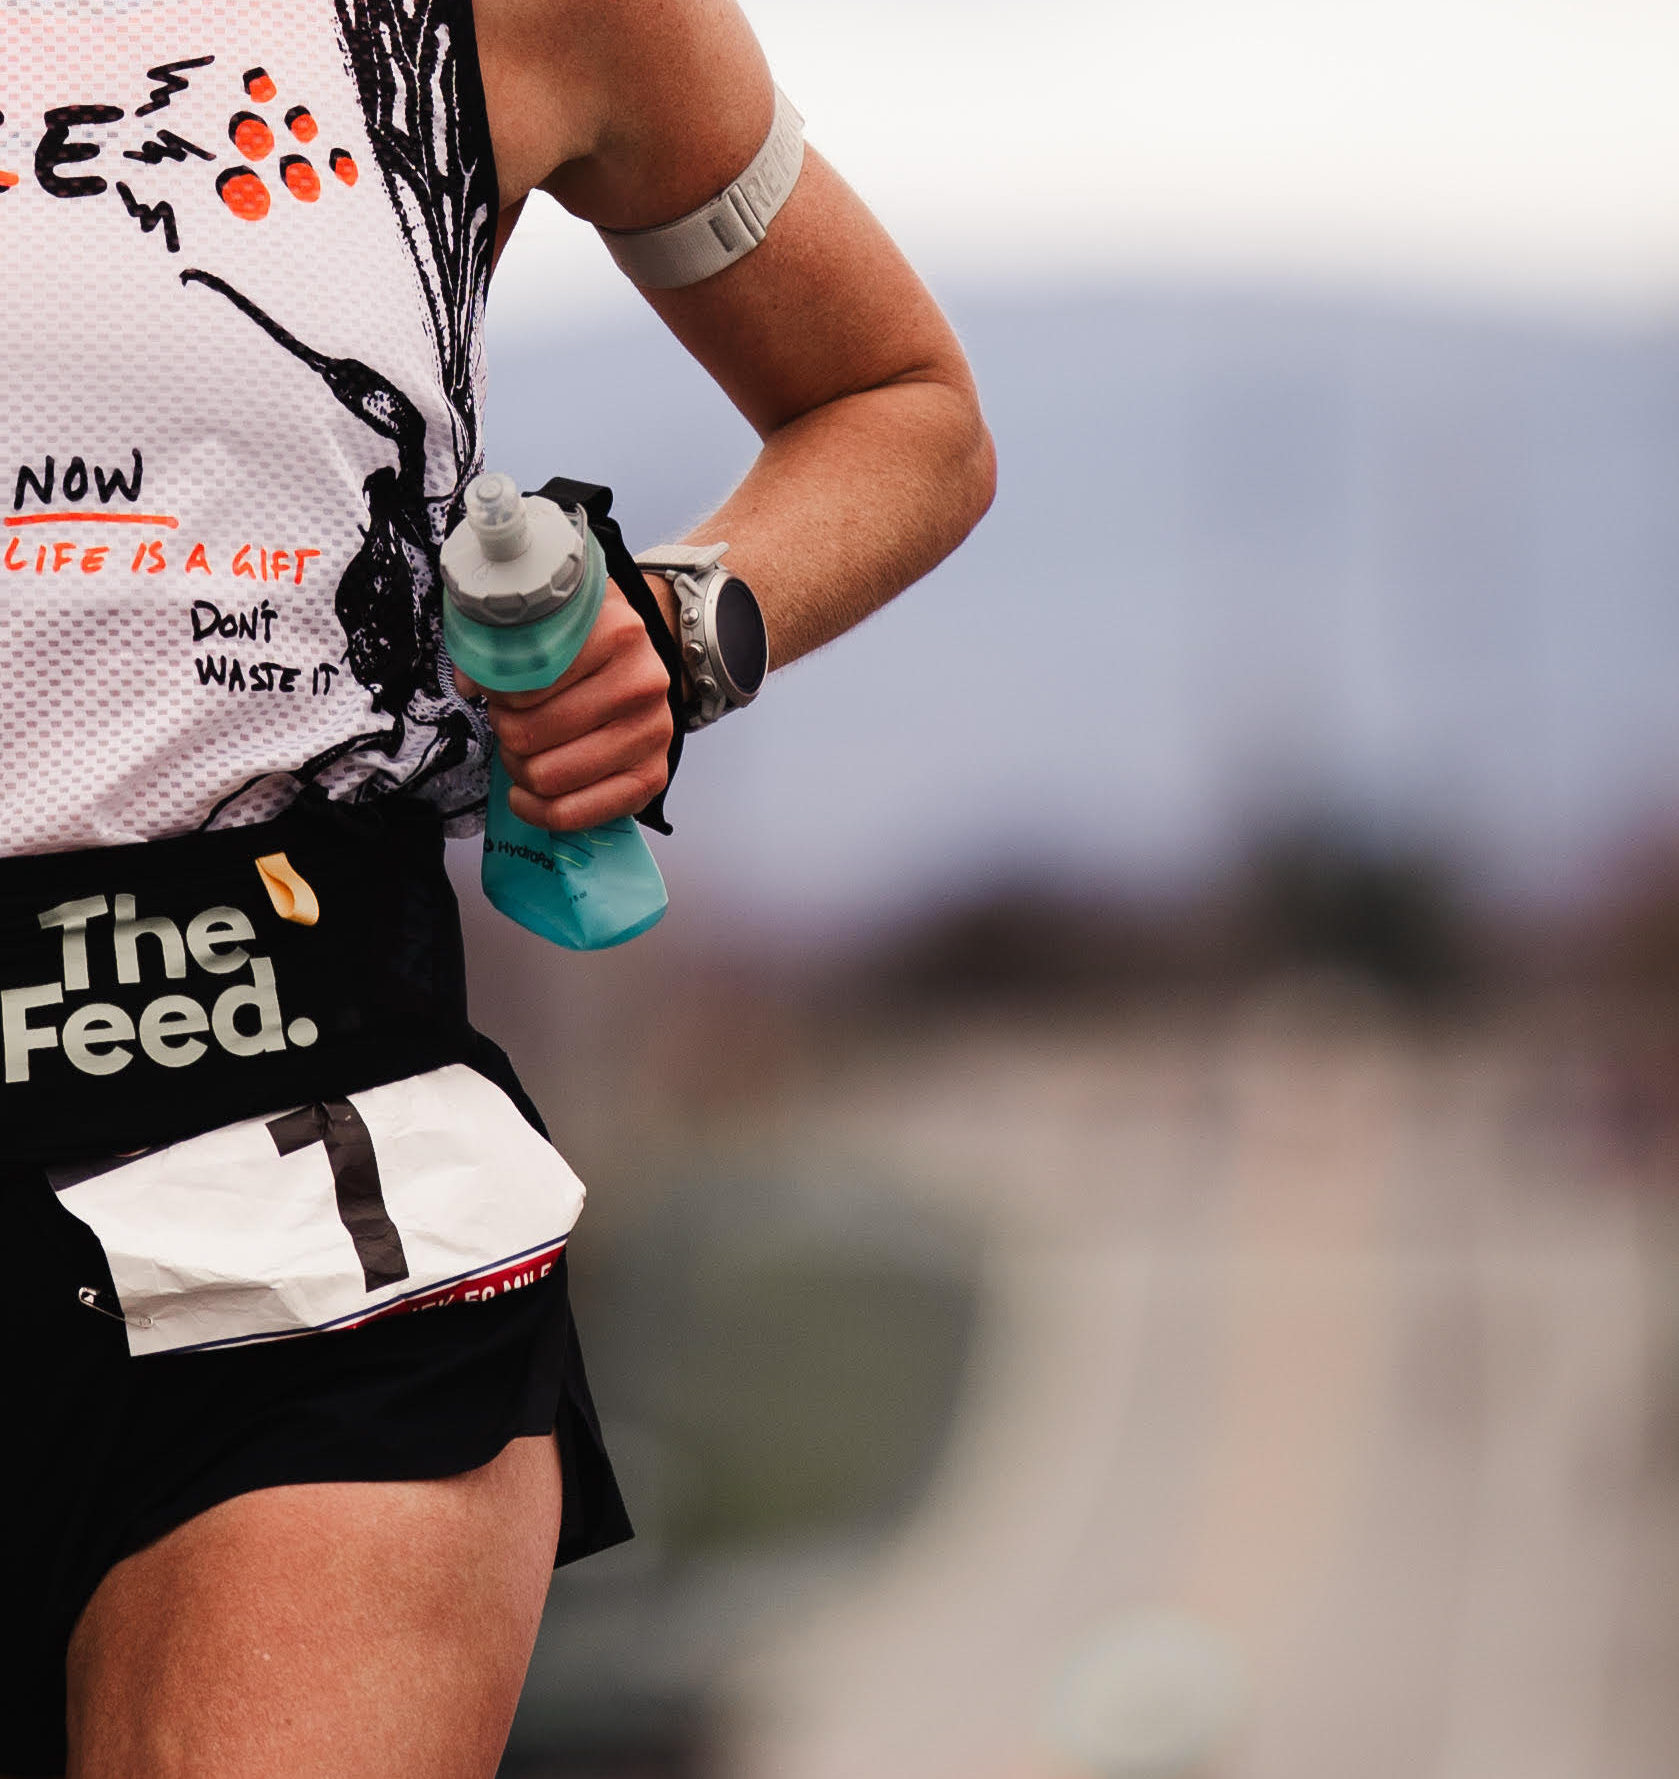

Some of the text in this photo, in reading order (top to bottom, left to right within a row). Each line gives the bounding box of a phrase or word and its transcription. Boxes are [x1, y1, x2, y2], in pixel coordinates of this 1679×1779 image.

[14, 448, 144, 511] NOW
[3, 536, 321, 585] LIFE IS A GIFT
[194, 654, 340, 696] WASTE IT
[37, 893, 257, 991] The
[1, 956, 319, 1084] Feed.
